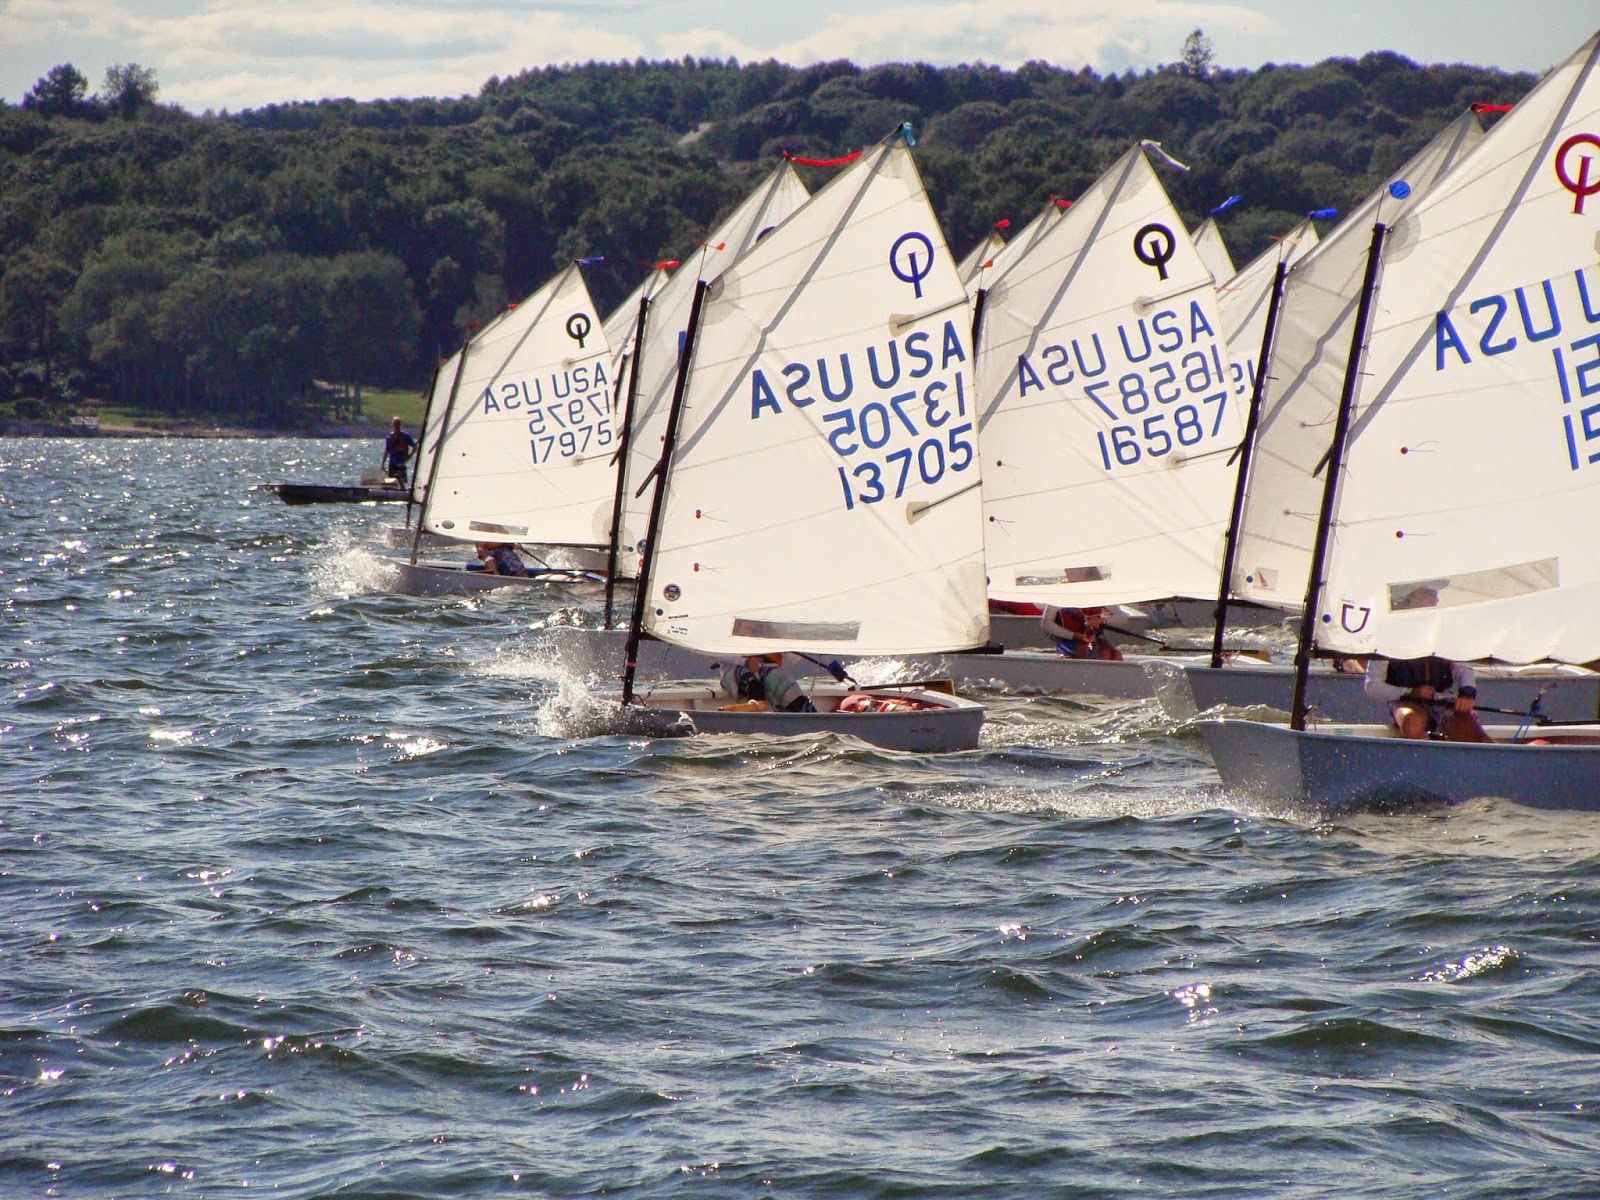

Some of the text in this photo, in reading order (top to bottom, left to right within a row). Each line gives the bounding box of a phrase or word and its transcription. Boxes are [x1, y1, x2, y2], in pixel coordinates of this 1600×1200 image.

[867, 320, 966, 390] USA
[1117, 300, 1215, 363] USA
[552, 361, 608, 399] USA
[530, 420, 612, 464] 17975
[1096, 391, 1228, 471] 16587
[838, 422, 973, 511] 13705
